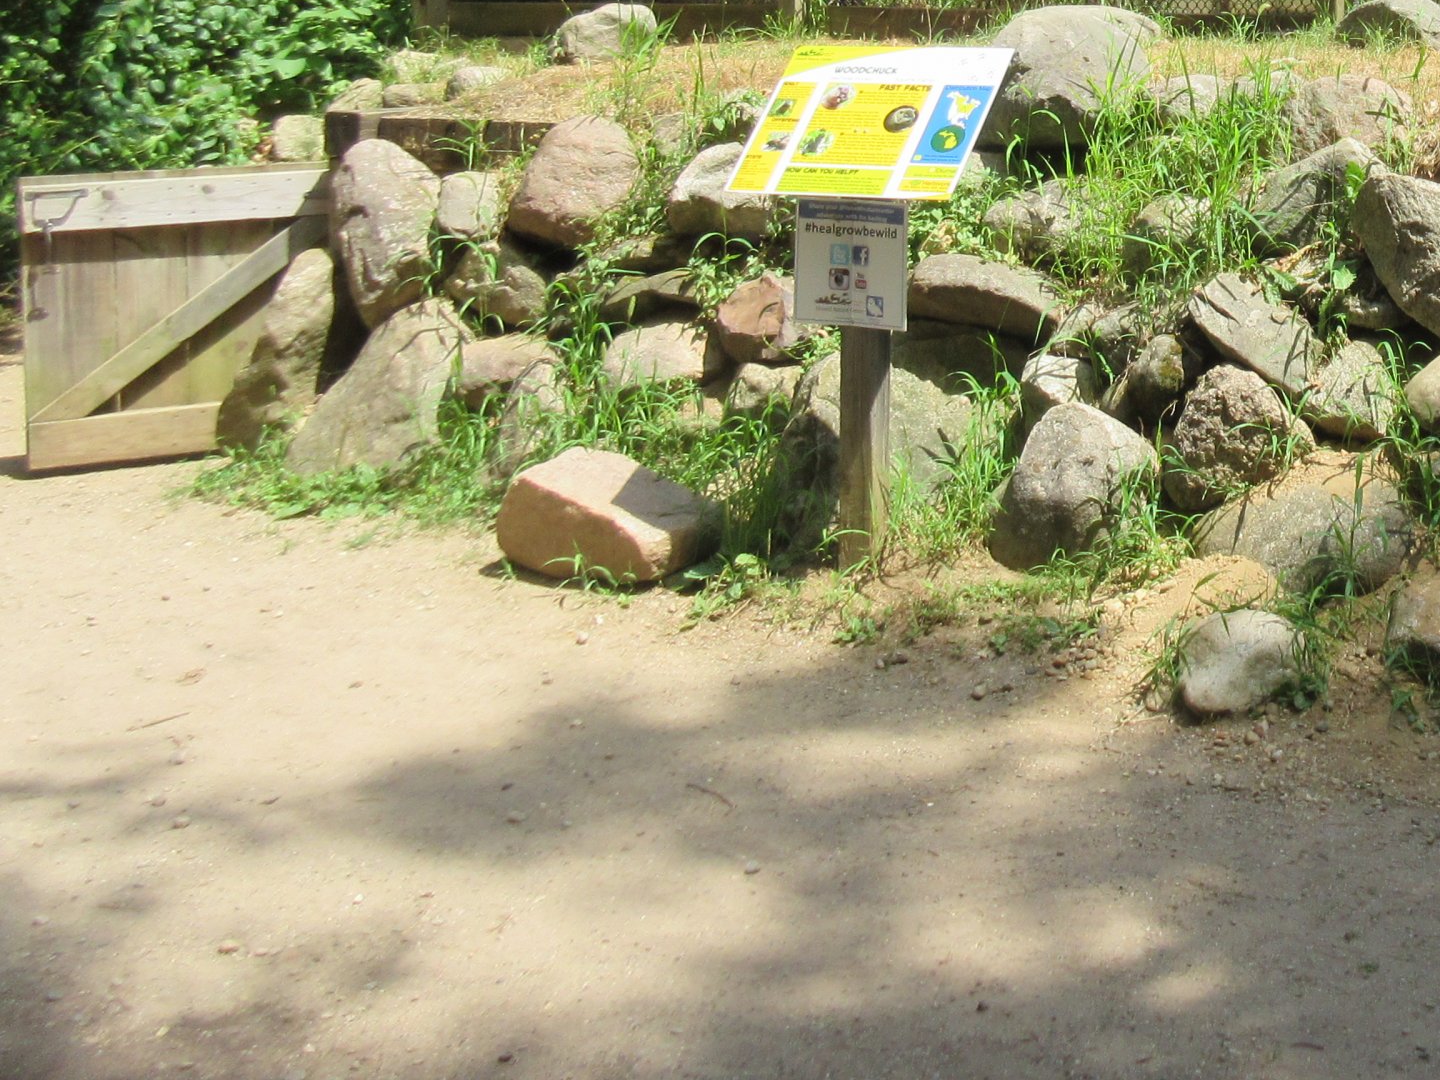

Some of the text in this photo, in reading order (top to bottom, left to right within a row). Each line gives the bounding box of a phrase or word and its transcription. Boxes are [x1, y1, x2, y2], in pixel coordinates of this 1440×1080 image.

[834, 66, 897, 74] WOODCHUCK
[904, 84, 933, 92] FACTS
[805, 221, 897, 239] #healgrowbewild
